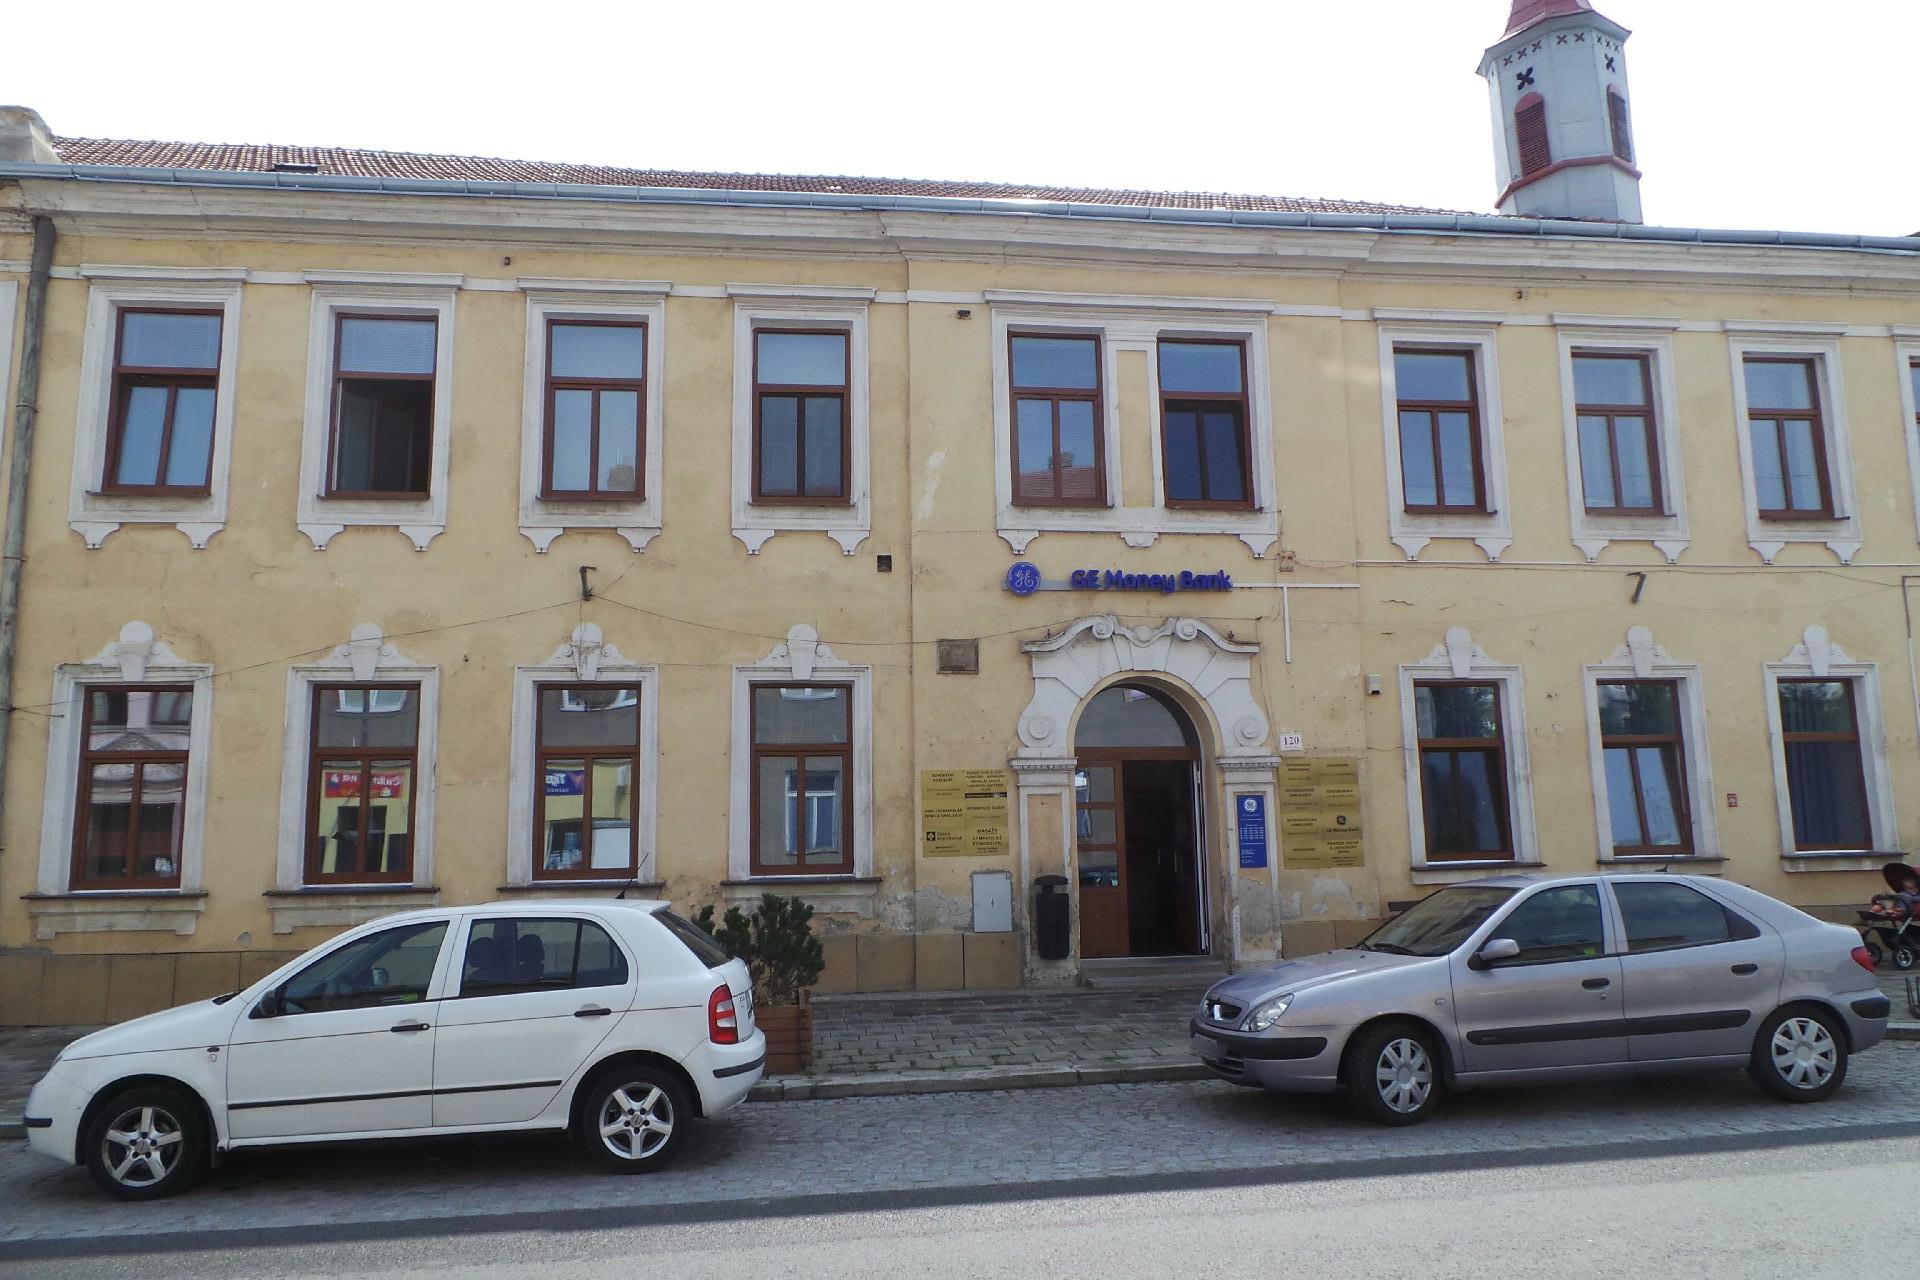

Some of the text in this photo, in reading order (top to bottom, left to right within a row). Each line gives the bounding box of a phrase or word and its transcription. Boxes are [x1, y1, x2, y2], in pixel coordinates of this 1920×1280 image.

[1071, 569, 1233, 594] GE Money Bank
[1284, 736, 1300, 746] 120
